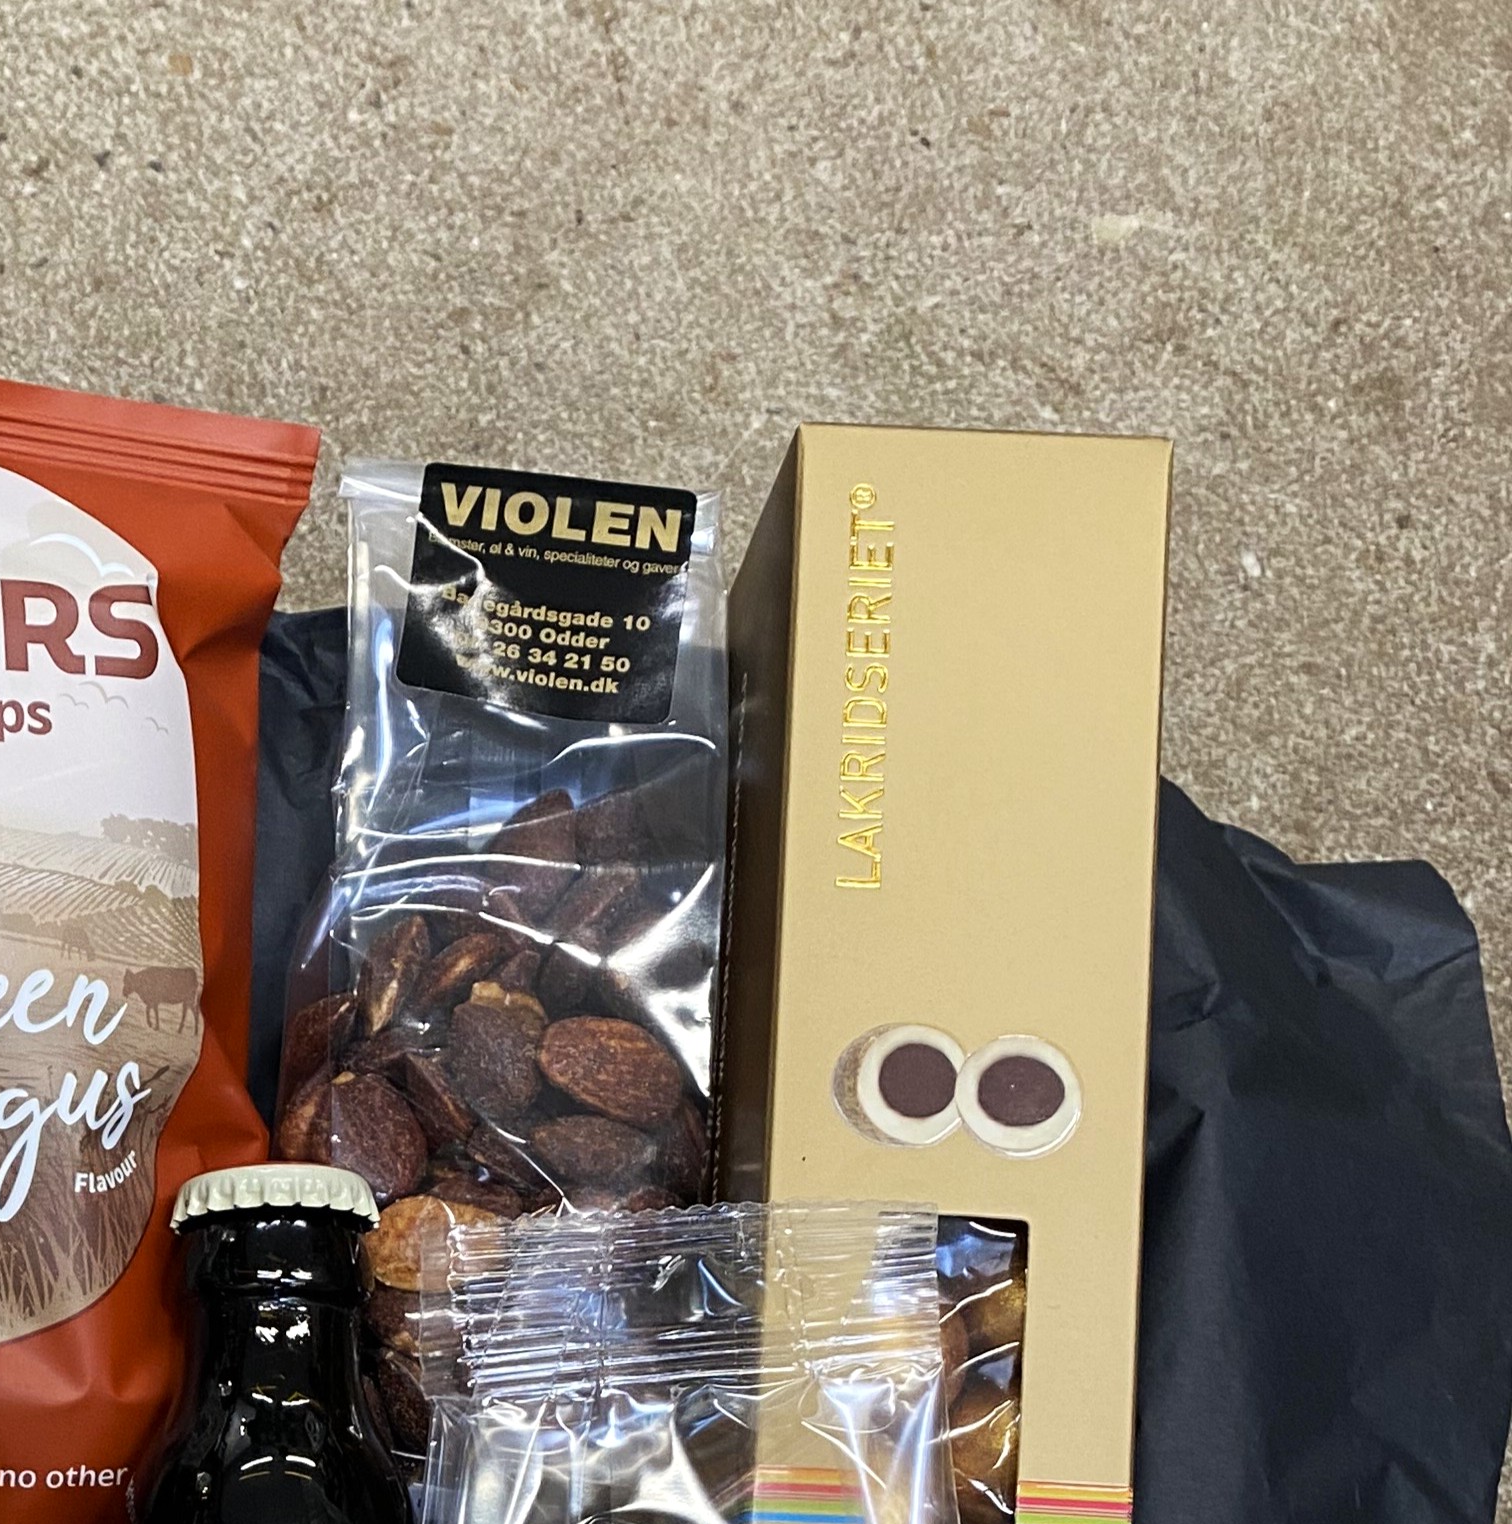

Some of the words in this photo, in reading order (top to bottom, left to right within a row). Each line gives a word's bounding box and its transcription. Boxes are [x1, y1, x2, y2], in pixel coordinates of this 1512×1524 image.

[441, 483, 682, 553] VIOLEN
[489, 542, 503, 555] øl
[504, 543, 515, 556] &
[518, 546, 540, 560] vin,
[544, 550, 620, 570] specialiteter
[622, 560, 640, 575] og
[642, 562, 680, 575] gaver
[441, 585, 614, 628] Baegårdsgade
[622, 615, 651, 632] 10
[492, 641, 521, 660] 26
[527, 647, 558, 667] 34
[563, 654, 592, 671] 21
[600, 657, 631, 674] 50
[539, 627, 611, 651] Odder
[455, 653, 619, 695] ww.violen.dk
[74, 1150, 139, 1195] Flavour
[45, 1464, 128, 1489] other
